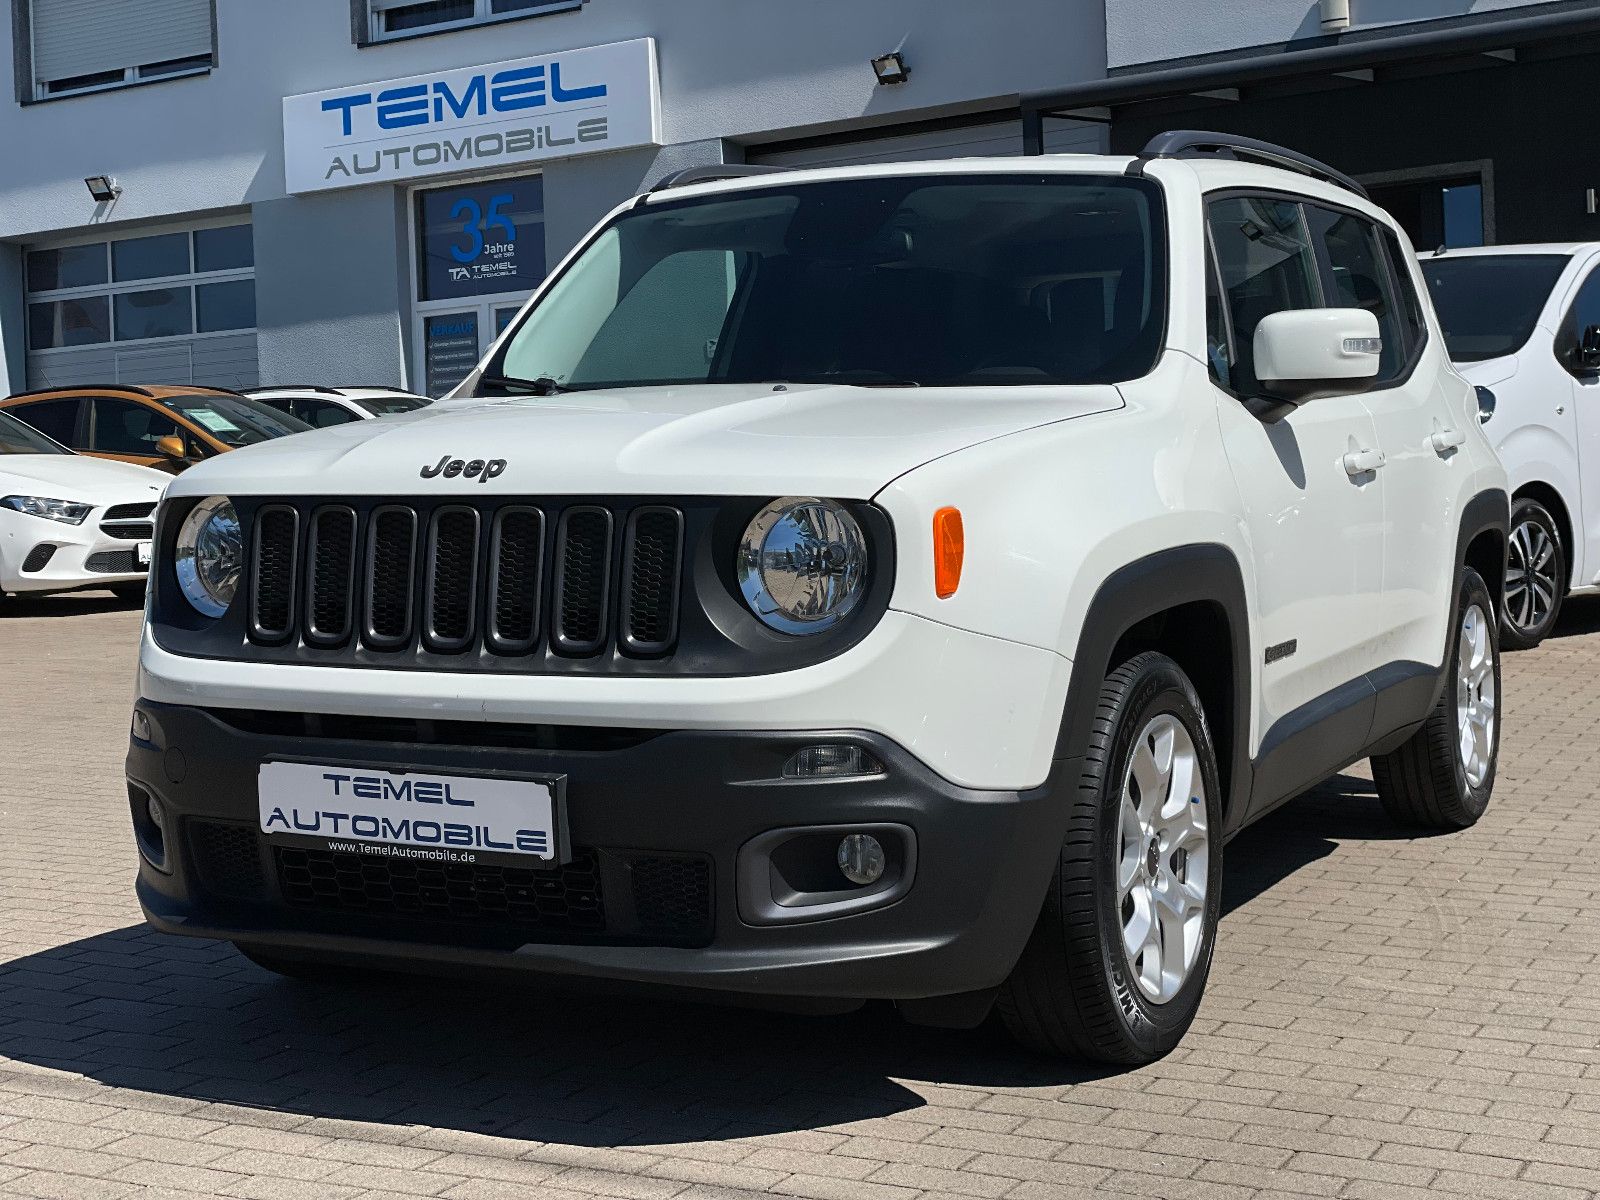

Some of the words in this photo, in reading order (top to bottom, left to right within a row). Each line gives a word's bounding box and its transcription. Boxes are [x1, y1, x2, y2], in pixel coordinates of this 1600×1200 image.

[321, 62, 607, 136] TEMEL
[449, 193, 517, 263] 35
[484, 242, 514, 255] Jahre
[472, 261, 518, 273] TEMEL
[420, 455, 508, 484] Jeep
[323, 773, 475, 807] TEMEL
[266, 806, 548, 853] AUTOMOBILE
[328, 840, 476, 863] www.TemelAutomobile.de
